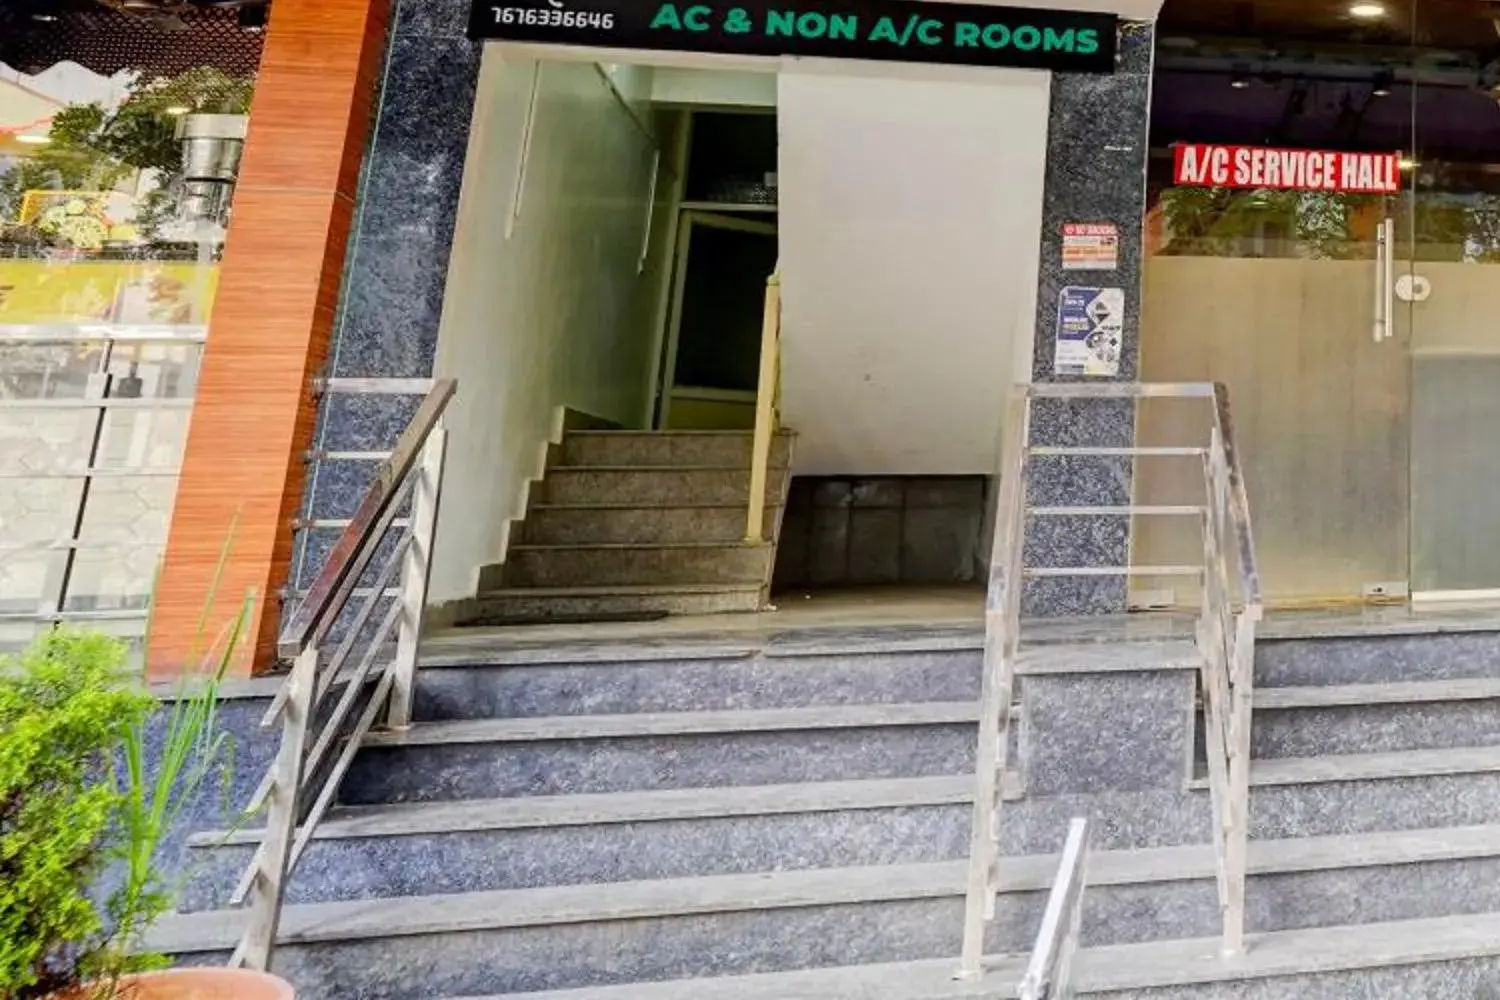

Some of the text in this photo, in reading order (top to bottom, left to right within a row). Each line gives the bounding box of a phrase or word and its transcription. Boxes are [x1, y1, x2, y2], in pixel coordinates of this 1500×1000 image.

[491, 6, 615, 29] 7676336646
[650, 3, 1099, 53] AC & NON A/C ROOMS
[1180, 146, 1397, 191] A/C SERVICE HALL
